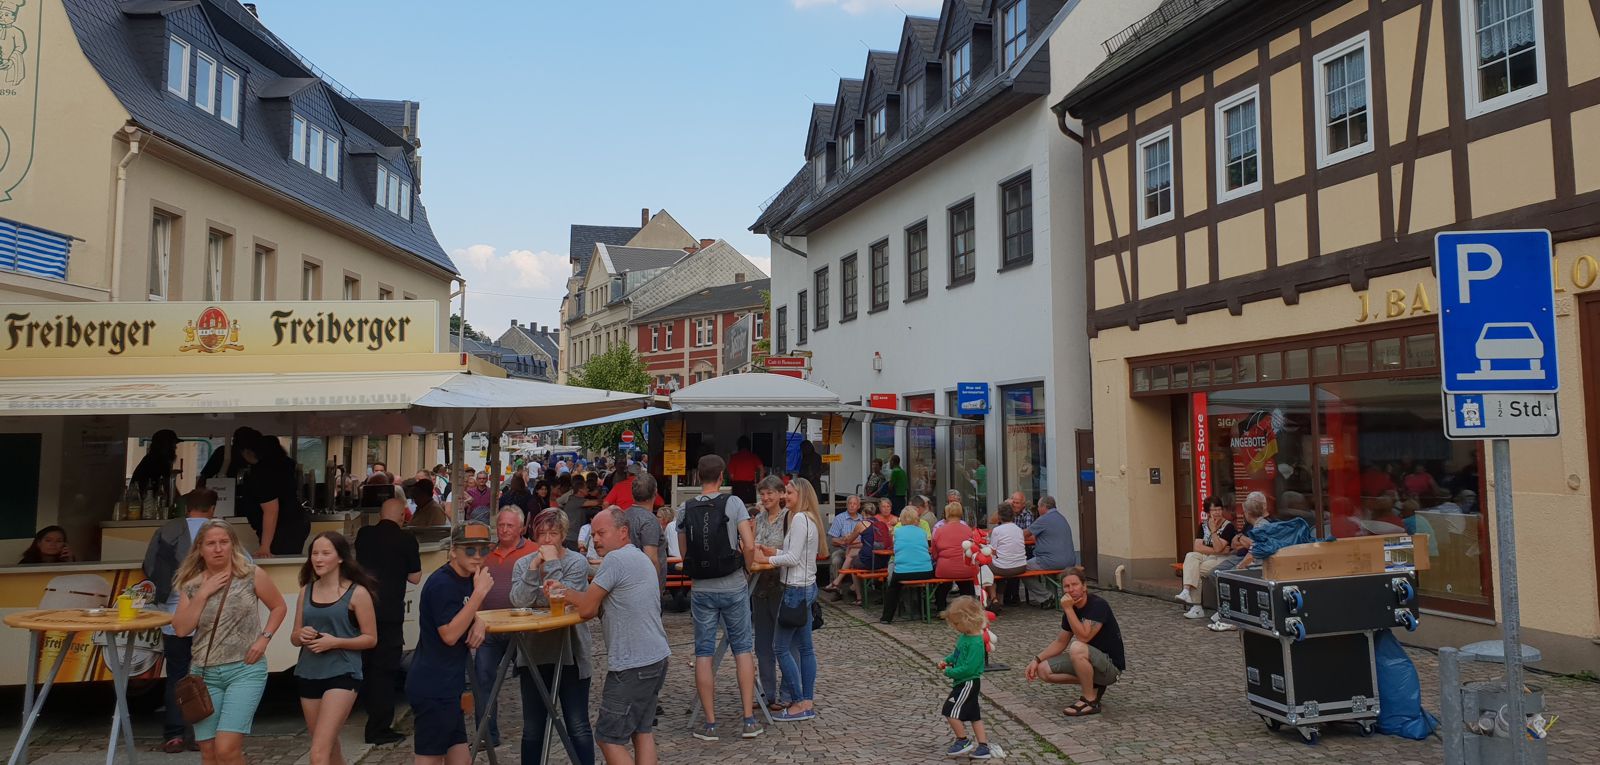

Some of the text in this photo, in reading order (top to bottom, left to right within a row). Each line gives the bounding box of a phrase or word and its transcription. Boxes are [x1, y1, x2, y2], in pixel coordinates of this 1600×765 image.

[1456, 243, 1503, 304] P
[4, 312, 156, 355] Freiberger
[270, 309, 412, 351] Freiberger
[1509, 401, 1548, 418] Std.
[1230, 436, 1266, 448] ANGEBOTE
[1197, 414, 1209, 520] Bsiness Store
